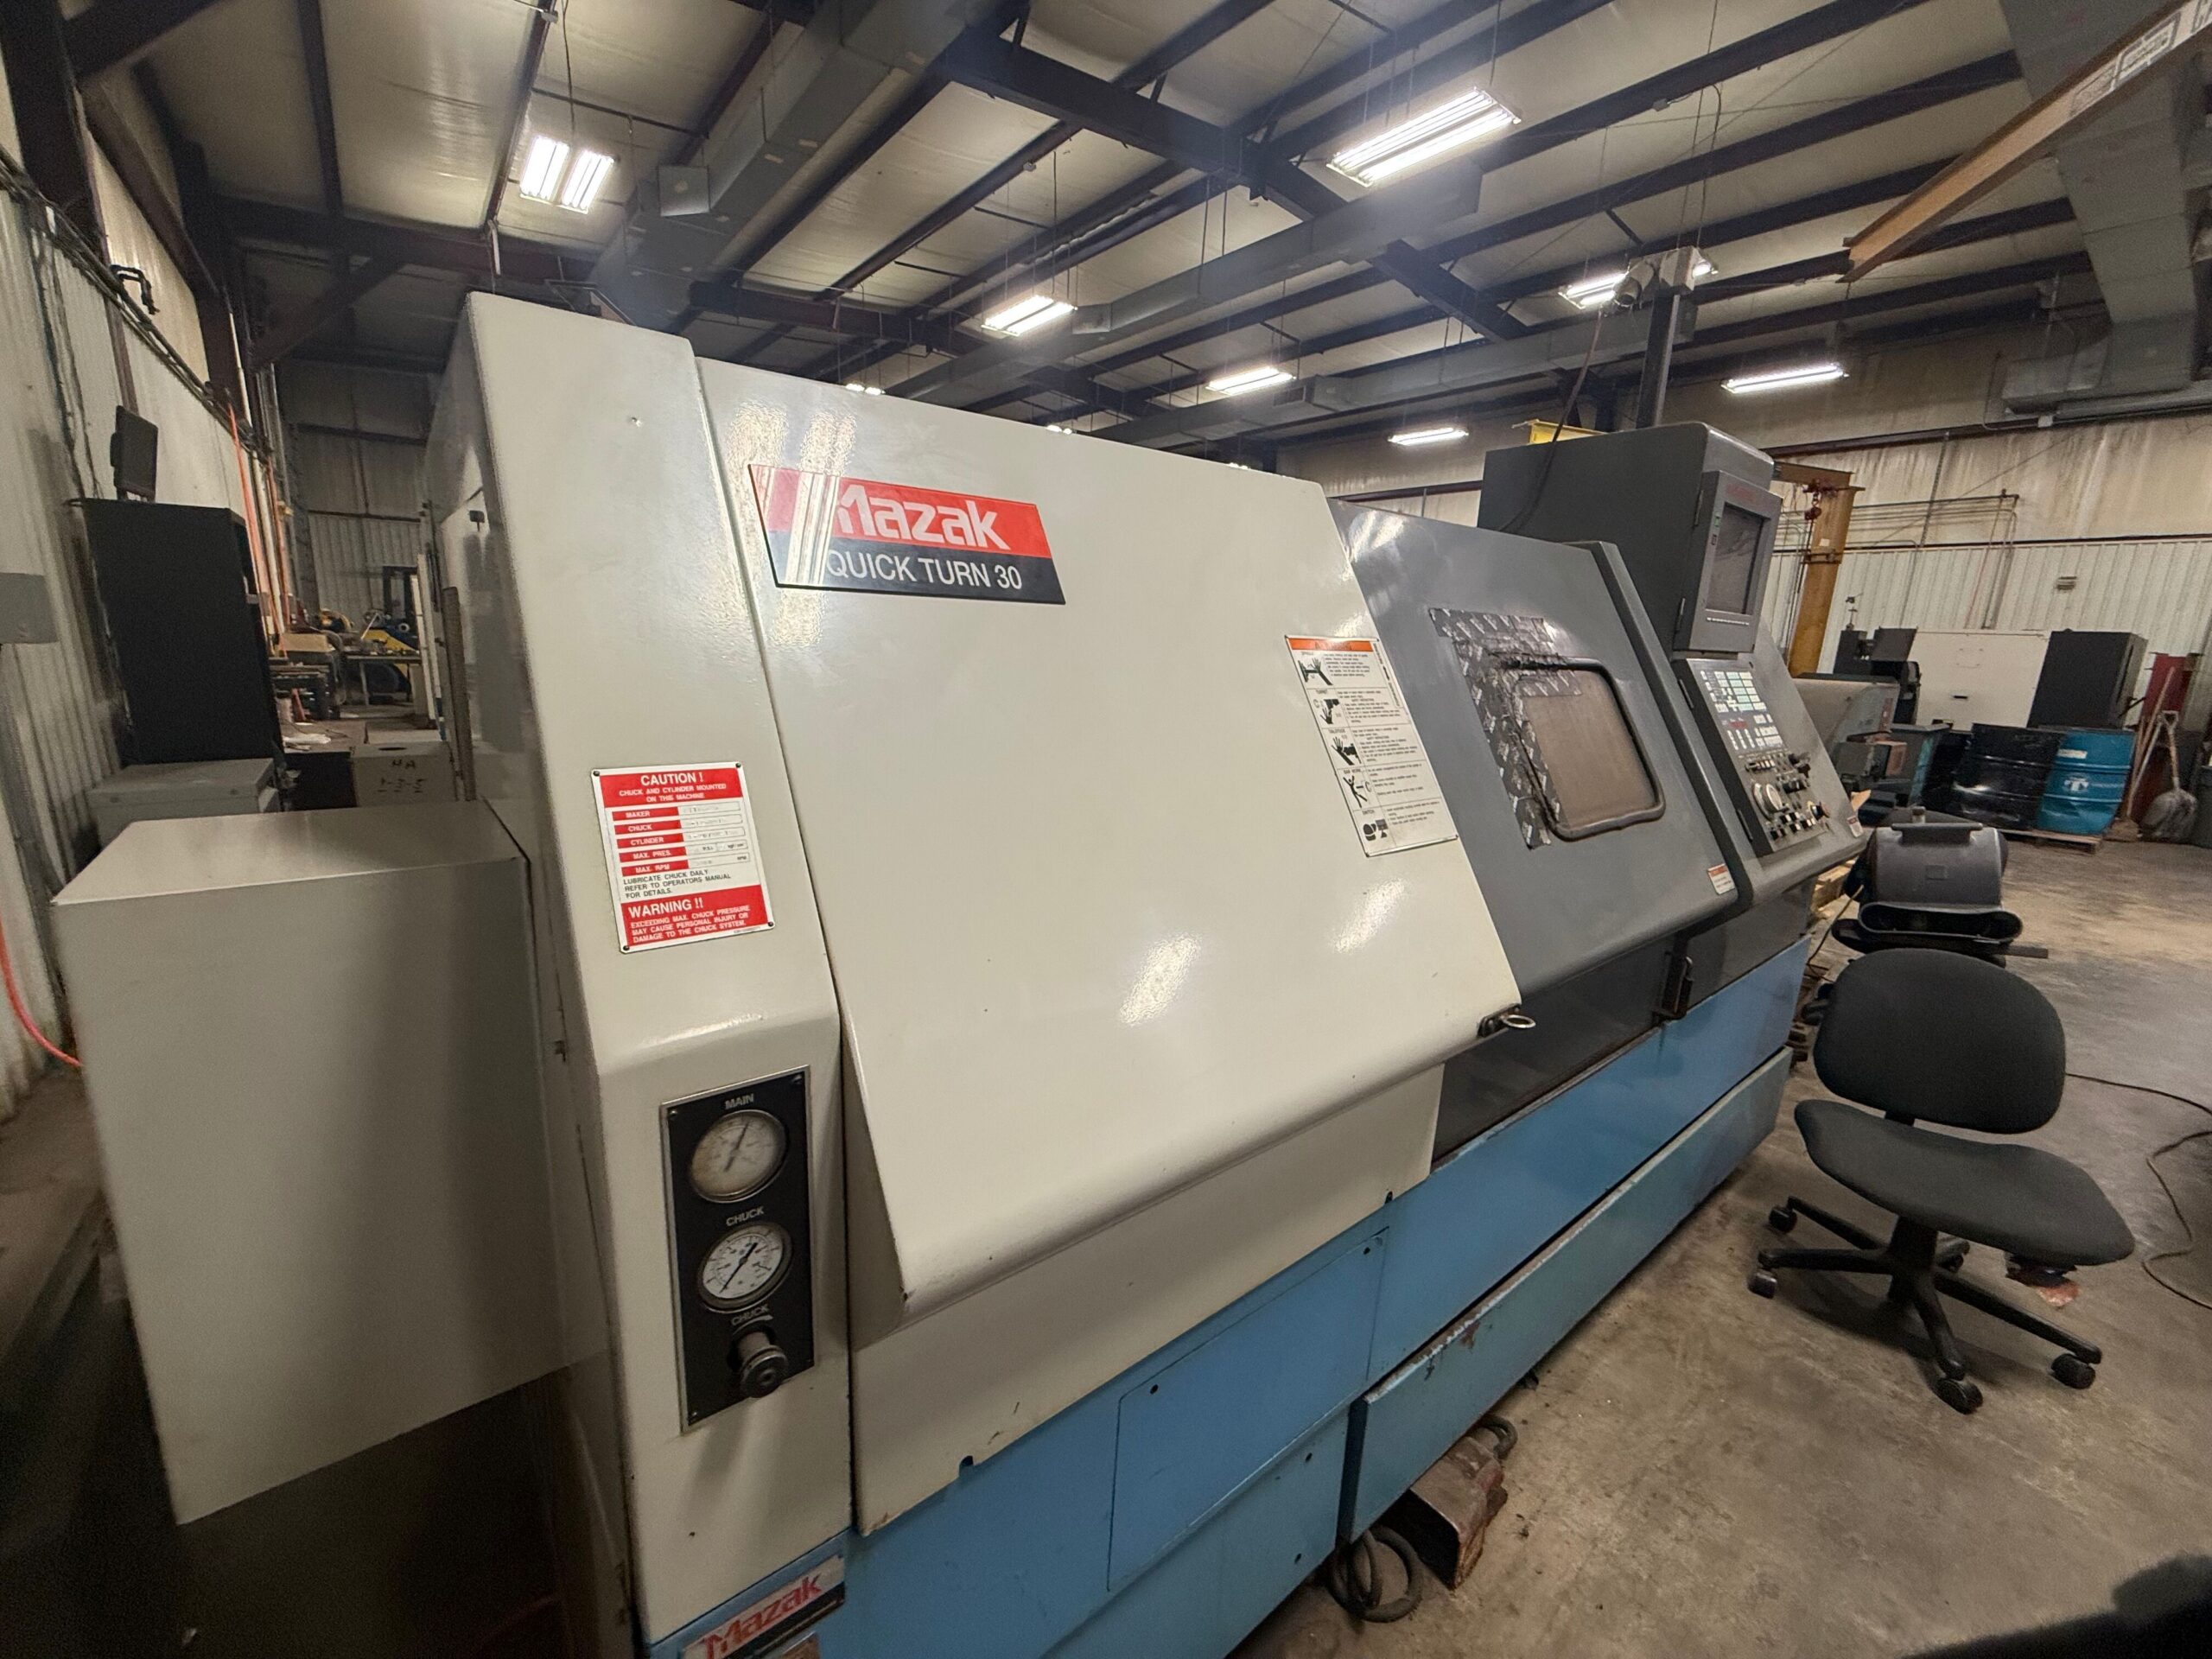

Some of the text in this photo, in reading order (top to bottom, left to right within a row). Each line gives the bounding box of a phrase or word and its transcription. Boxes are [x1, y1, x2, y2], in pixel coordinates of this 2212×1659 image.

[834, 484, 1010, 550] Mazak
[826, 549, 1023, 590] QUICK TURN 30
[640, 772, 704, 786] CAUTION !
[662, 785, 695, 794] CYLINDER
[696, 783, 727, 791] MOUNTED
[677, 792, 705, 801] MACHINE
[628, 823, 652, 832] CHUCK
[631, 836, 664, 846] CYLINDER
[632, 849, 672, 860] MAX. PRES.
[623, 868, 709, 886] LUBRICATE CHUCK DAILY
[655, 863, 671, 872] RPM
[624, 883, 648, 893] REFER
[663, 877, 702, 887] OPERATORS
[705, 873, 732, 882] MANUAL
[643, 887, 673, 898] DETAILS.
[628, 897, 704, 918] WARNING !!
[630, 918, 671, 929] EXCEEDING
[691, 911, 715, 920] CHUCK
[716, 905, 751, 916] PRESSURE
[632, 927, 647, 936] MAY
[650, 924, 674, 934] CAUSE
[676, 918, 712, 929] PERSONAL
[713, 914, 736, 924] INJURY
[632, 933, 664, 944] DAMAGE
[677, 927, 692, 937] THE
[694, 925, 717, 934] CHUCK
[719, 919, 747, 930] SYSTEM.
[725, 1092, 754, 1109] MAIN
[726, 1205, 765, 1227] CHUCK
[731, 1303, 769, 1325] CHUCK
[702, 1574, 822, 1659] Mazak
